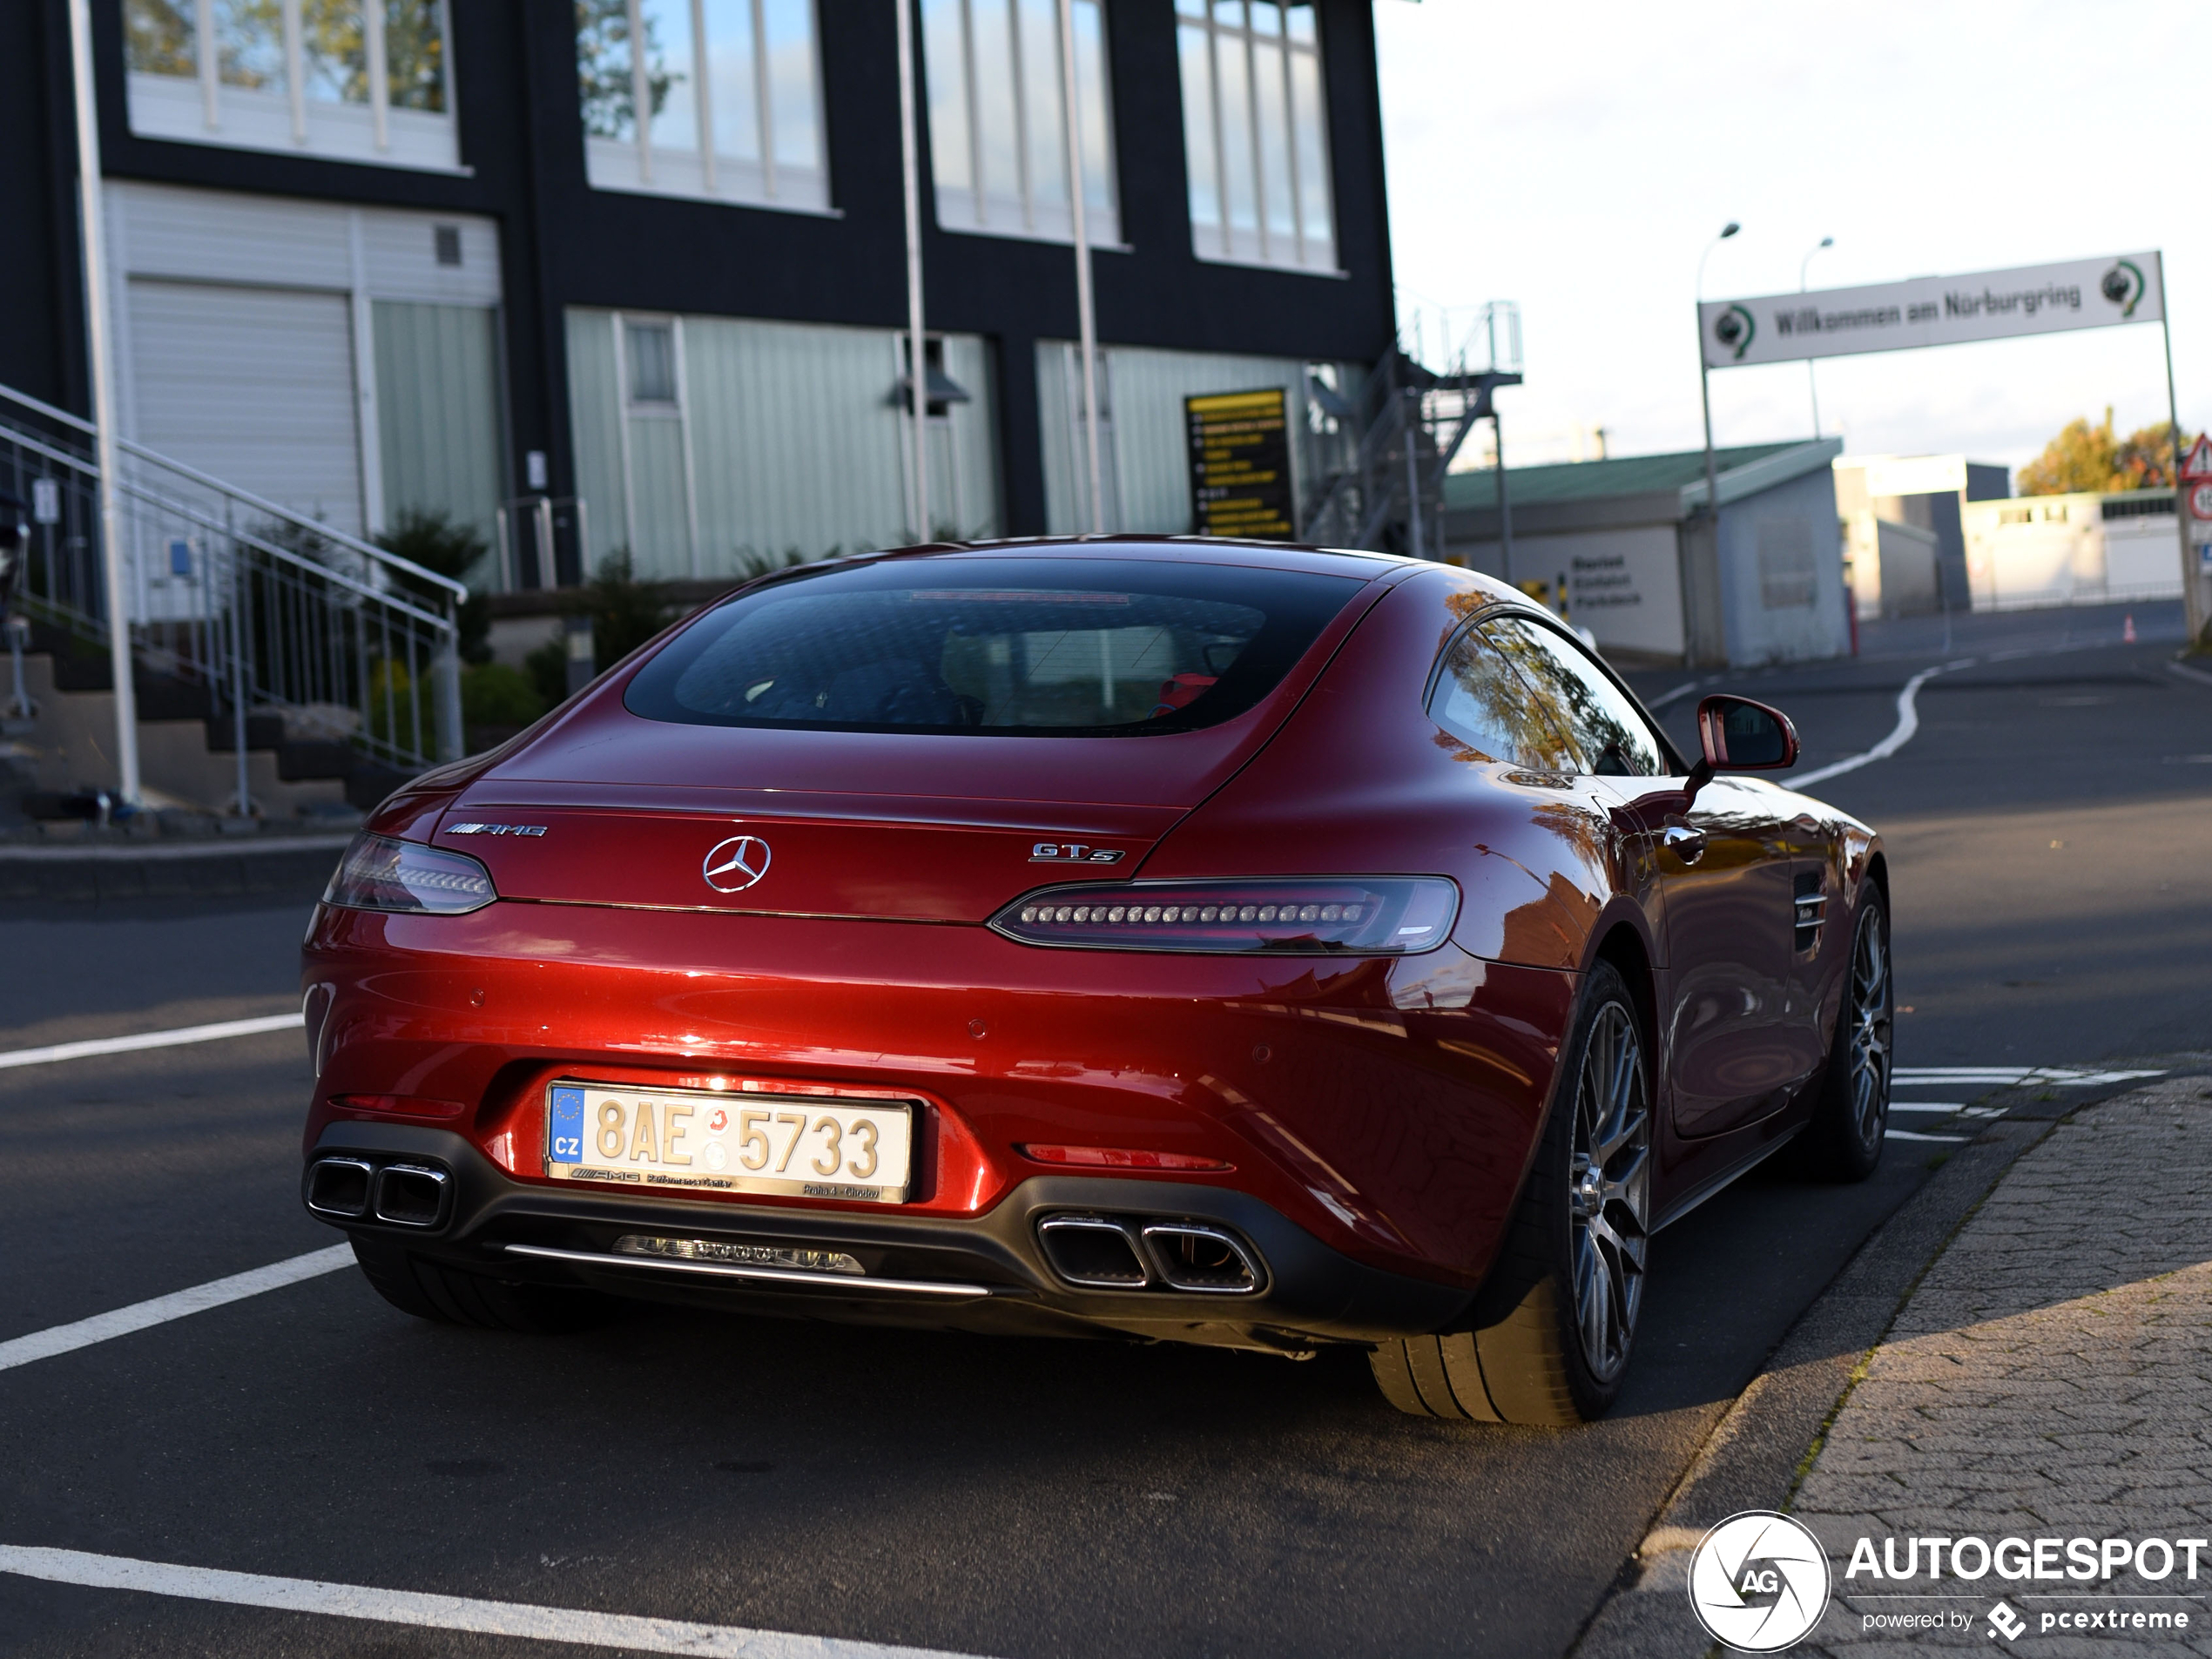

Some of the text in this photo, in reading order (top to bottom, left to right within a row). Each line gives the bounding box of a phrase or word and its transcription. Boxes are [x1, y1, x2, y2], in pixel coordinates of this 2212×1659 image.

[1775, 305, 1901, 336] Willkommen
[1907, 300, 1939, 320] am
[475, 823, 549, 837] AMG
[555, 1136, 579, 1156] CZ
[597, 1099, 879, 1179] 8AE 5733
[592, 1170, 640, 1182] AMG
